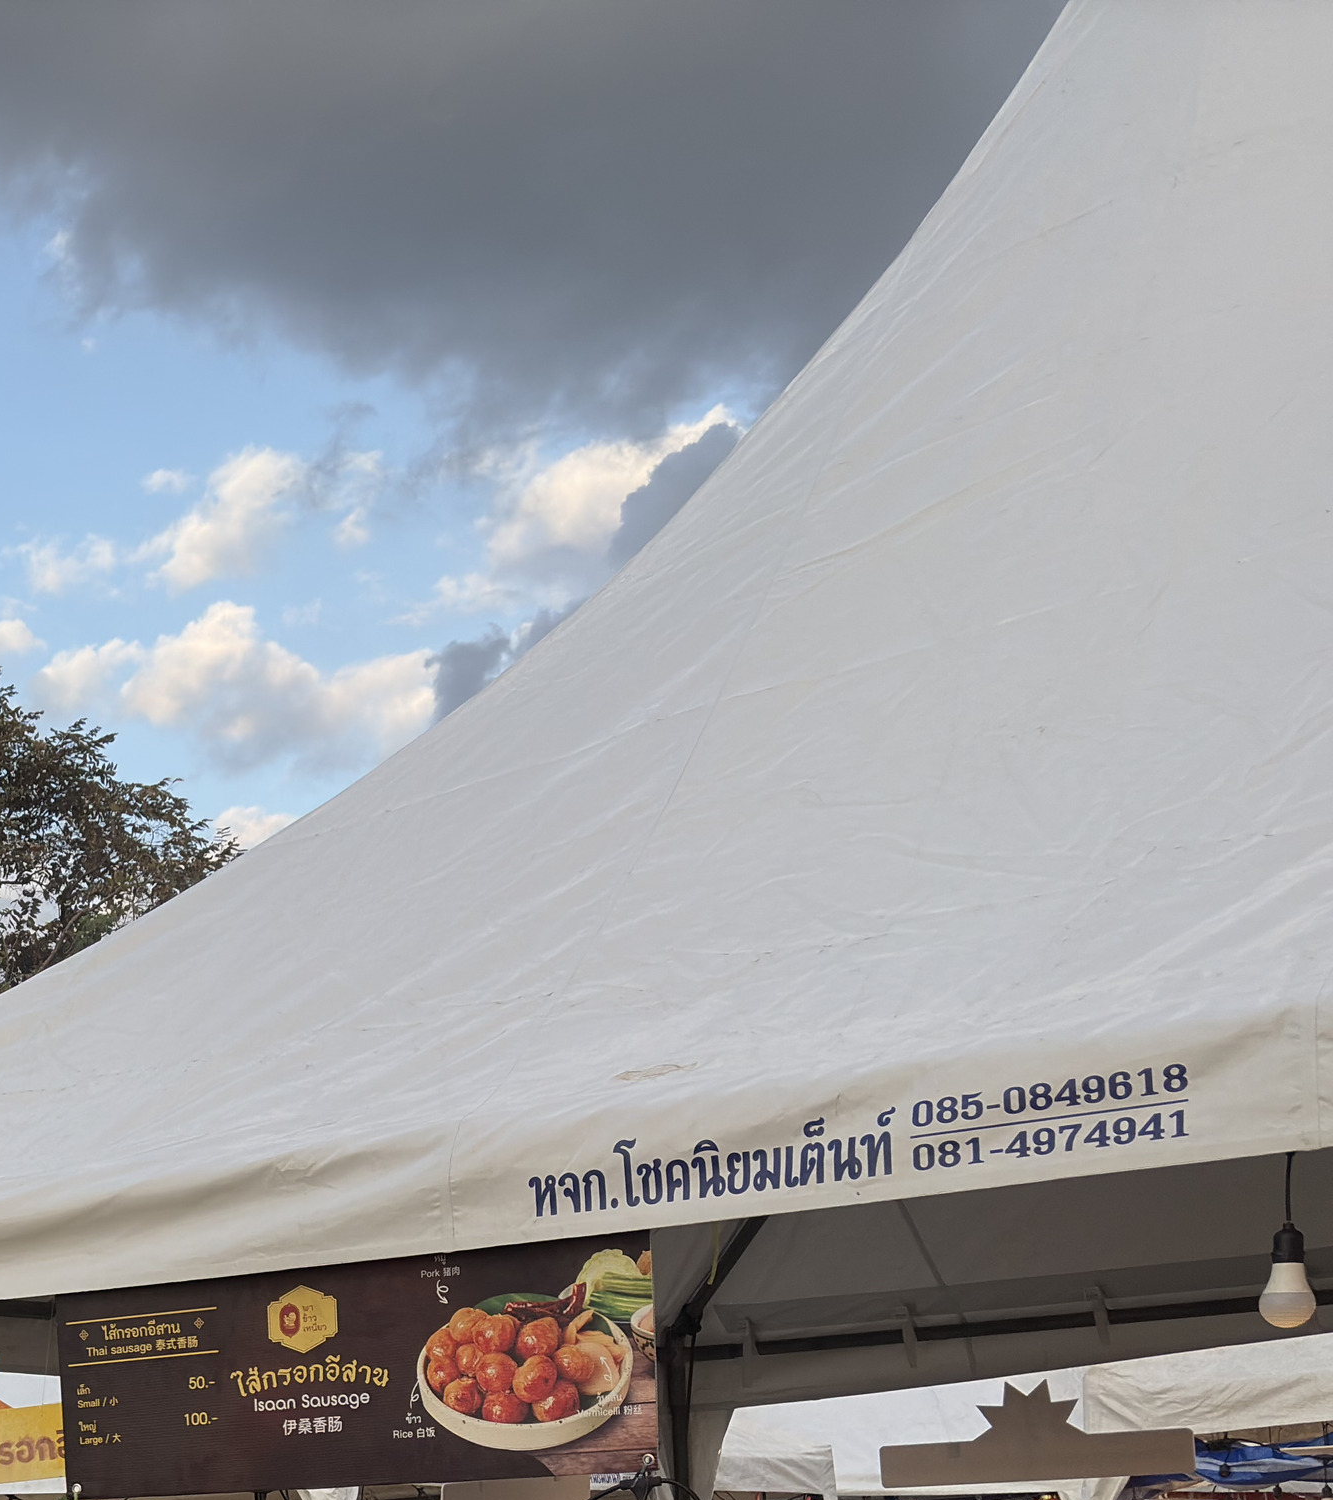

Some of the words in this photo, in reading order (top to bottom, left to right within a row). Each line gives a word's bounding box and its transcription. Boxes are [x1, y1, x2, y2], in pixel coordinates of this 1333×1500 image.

[912, 1063, 1190, 1127] 085-0849618
[913, 1110, 1190, 1171] 081-4974941
[528, 1106, 896, 1218] หจก.โชคนิยมเต็นท์
[420, 1269, 440, 1279] Pork
[443, 1266, 460, 1277] 猪肉
[102, 1320, 182, 1342] ไส้กรอกอีสาน
[86, 1346, 108, 1358] Thai
[110, 1342, 153, 1357] sausage
[155, 1335, 199, 1351] 泰式香肠
[188, 1376, 216, 1390] 50.-
[230, 1354, 390, 1397] ไส้กรอกอีสาน
[77, 1383, 91, 1396] เล็ก
[77, 1399, 100, 1409] Small
[109, 1396, 119, 1406] 小
[254, 1397, 296, 1412] Isaan
[301, 1392, 371, 1410] Sausage
[184, 1412, 219, 1427] 100.-
[282, 1416, 343, 1436] 伊桑香肠
[405, 1412, 422, 1425] ข้าว
[79, 1420, 97, 1434] ใหญ่
[392, 1429, 414, 1440] Rice
[416, 1427, 436, 1439] 白饭
[79, 1434, 103, 1446] Large
[112, 1433, 122, 1443] 大
